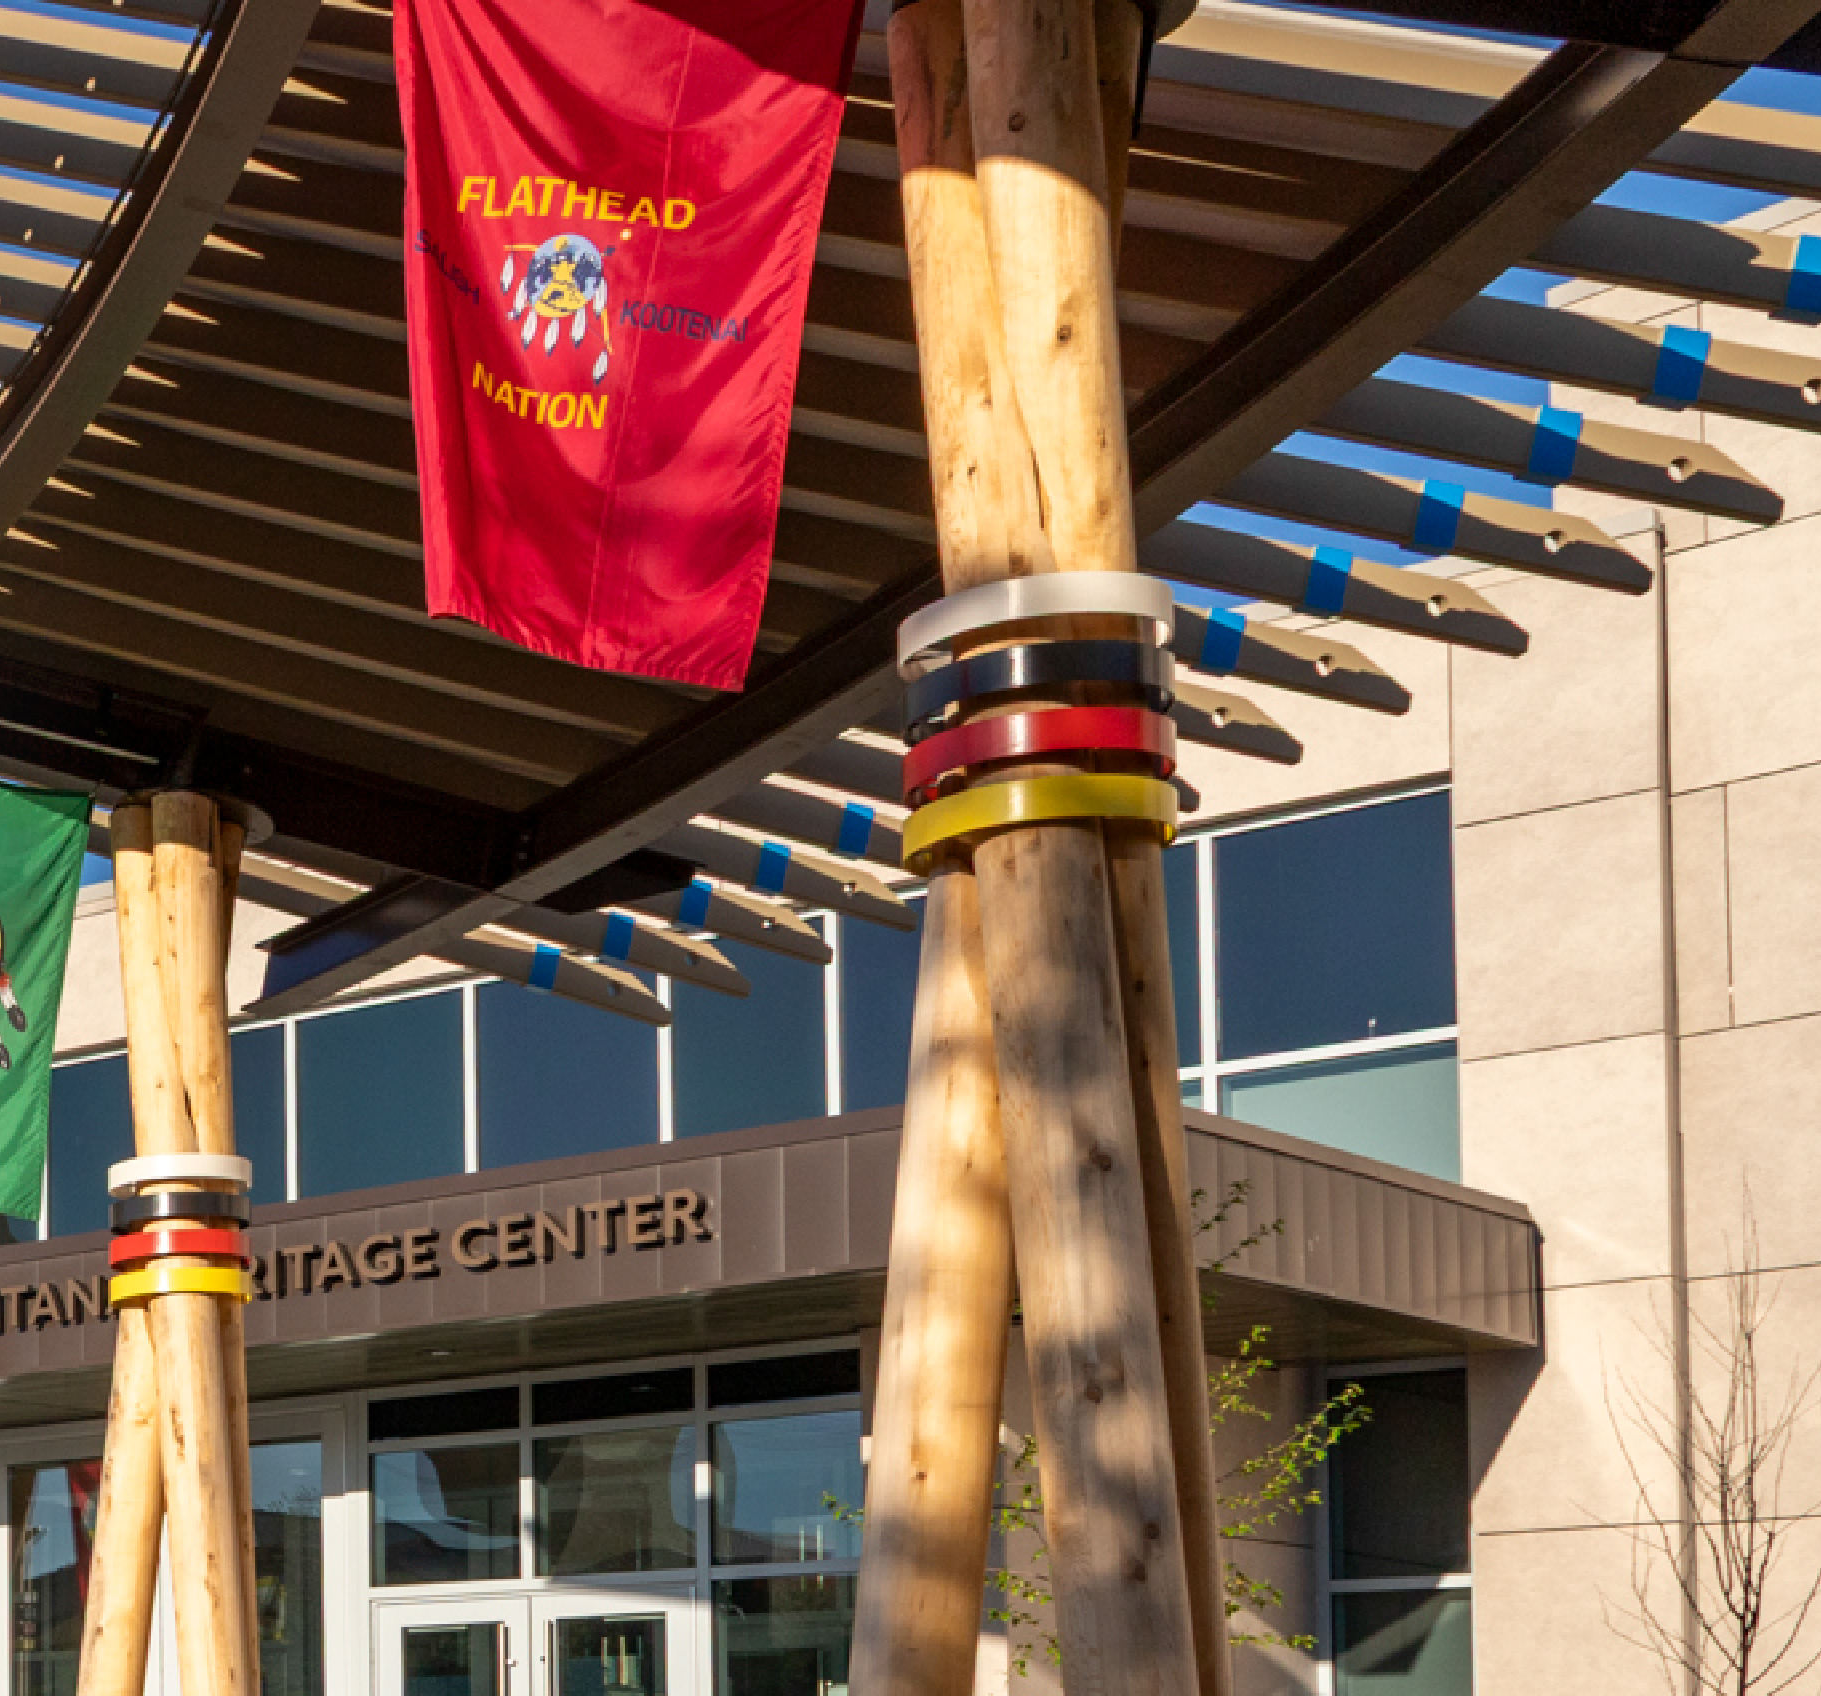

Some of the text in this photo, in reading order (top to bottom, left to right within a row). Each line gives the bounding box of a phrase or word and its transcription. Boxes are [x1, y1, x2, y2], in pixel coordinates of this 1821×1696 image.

[457, 176, 696, 229] FLATHEAD
[619, 299, 748, 343] KOOTENAI
[472, 360, 608, 429] NATION
[451, 1187, 713, 1271] CENTER
